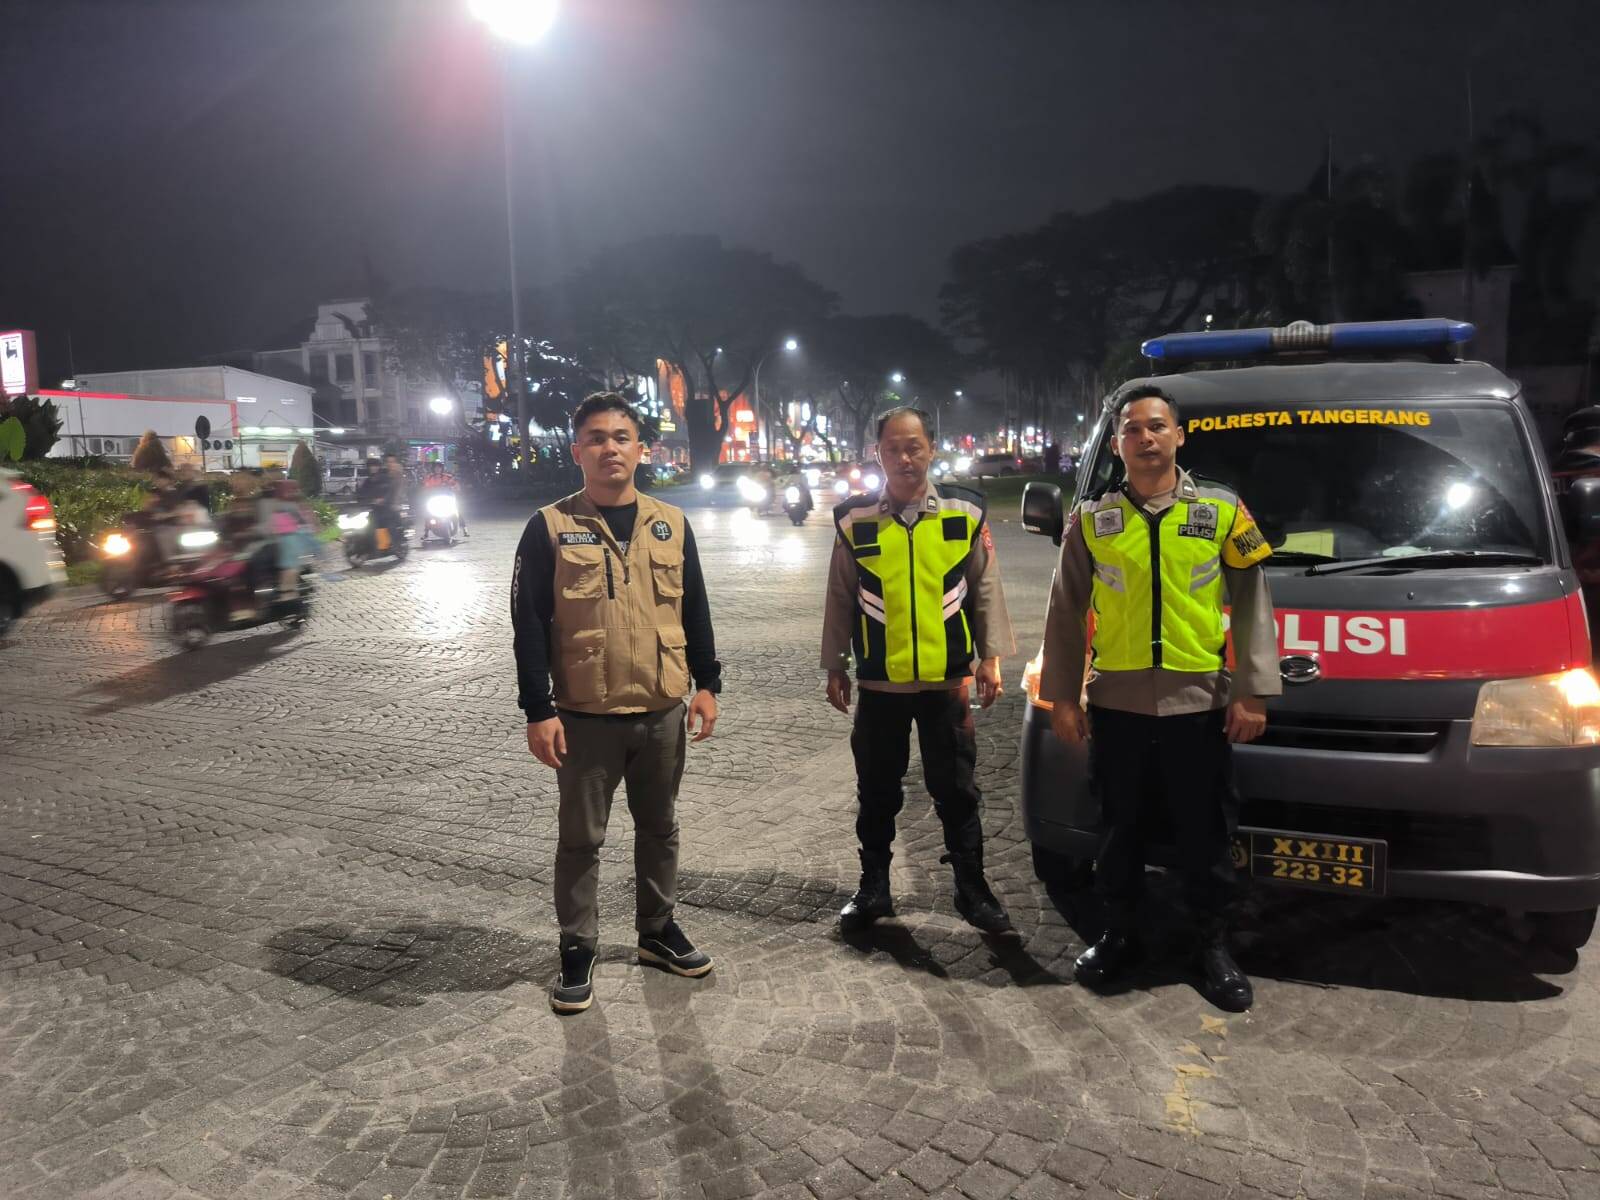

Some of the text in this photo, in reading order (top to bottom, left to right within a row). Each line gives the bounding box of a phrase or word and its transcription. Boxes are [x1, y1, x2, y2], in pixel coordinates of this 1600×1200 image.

[1188, 410, 1431, 433] POLRESTA TANGERANG
[1179, 525, 1215, 539] POLISI
[1222, 612, 1407, 656] LISI
[1272, 838, 1364, 863] XXIII
[1272, 860, 1364, 887] 223-32
